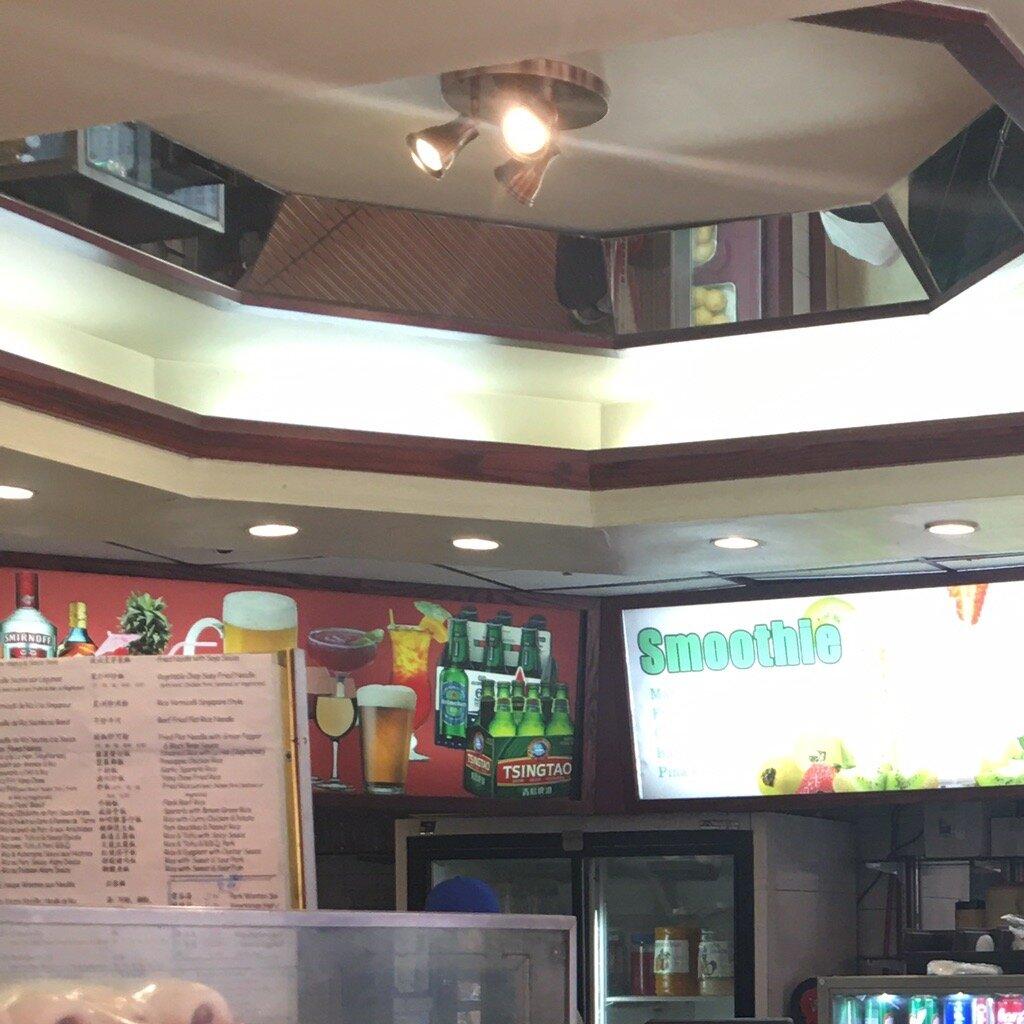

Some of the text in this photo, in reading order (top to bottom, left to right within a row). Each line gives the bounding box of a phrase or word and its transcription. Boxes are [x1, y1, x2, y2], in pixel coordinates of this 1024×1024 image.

[4, 632, 52, 645] SMIRNOFF
[637, 618, 842, 675] Smoothie
[503, 762, 573, 780] TSINGTAO
